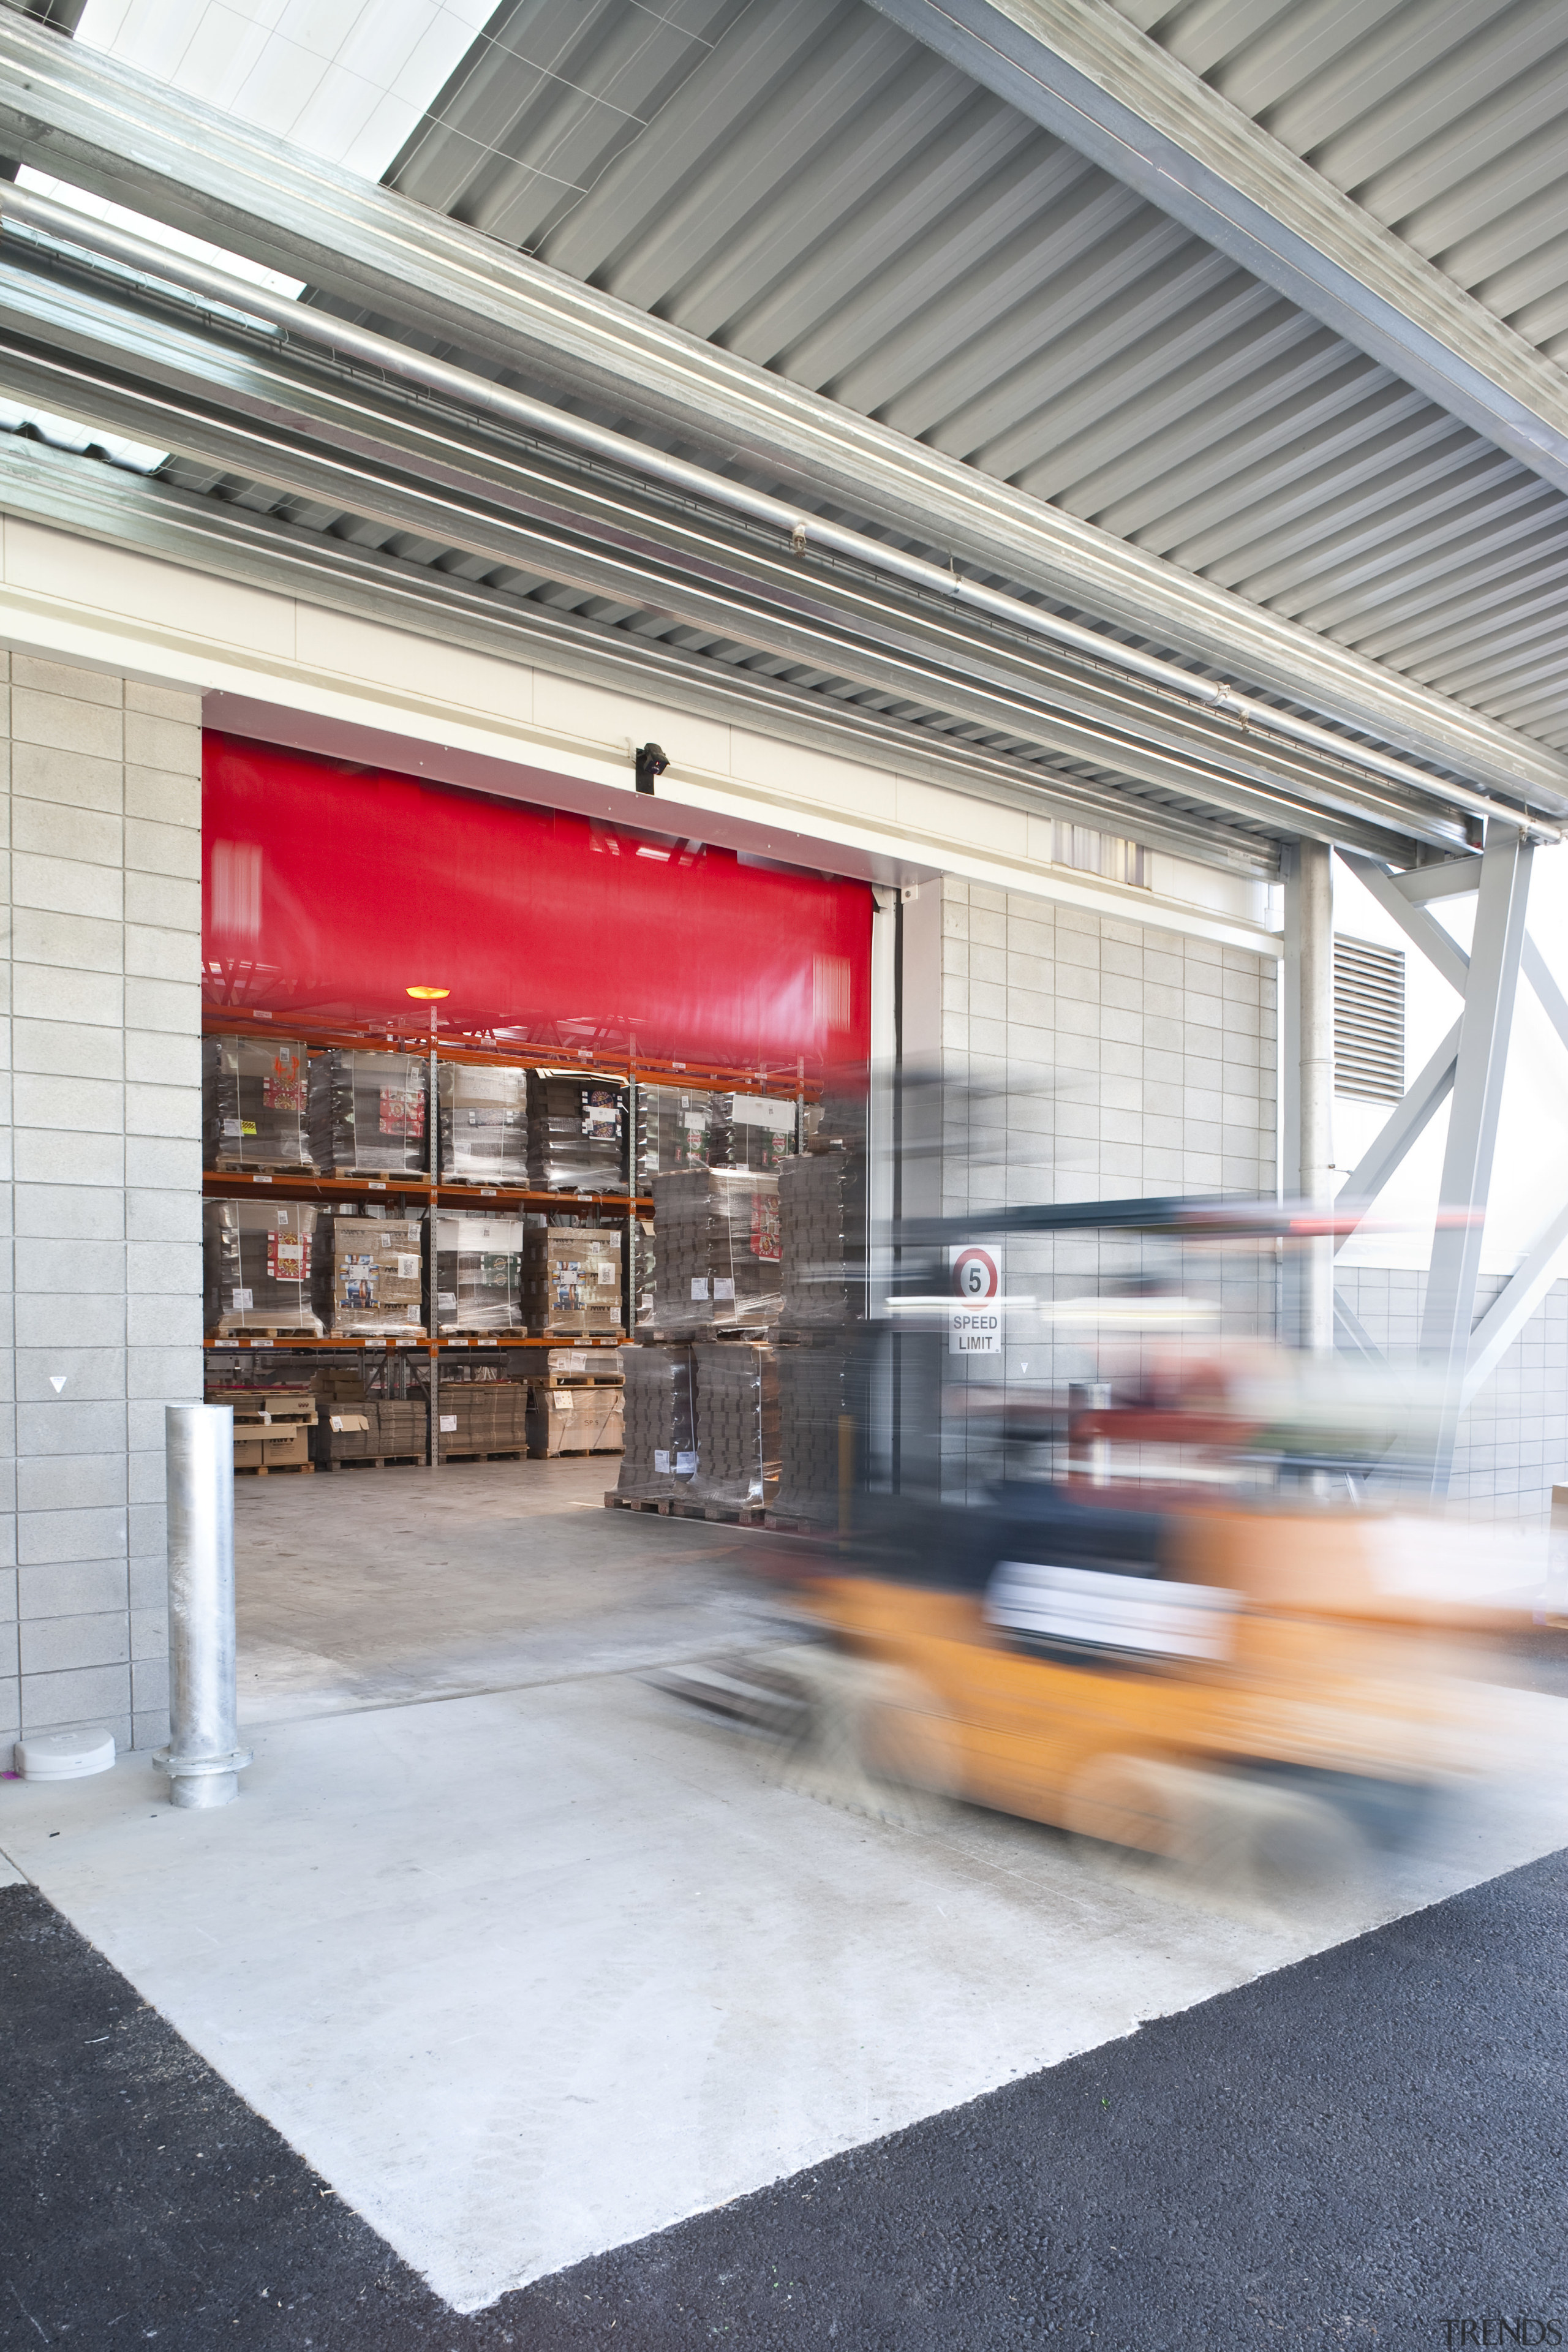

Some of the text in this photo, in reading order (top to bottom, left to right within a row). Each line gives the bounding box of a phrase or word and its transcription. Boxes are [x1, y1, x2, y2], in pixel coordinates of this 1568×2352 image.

[968, 1267, 981, 1292] 5
[953, 1316, 998, 1329] SPEED
[959, 1336, 993, 1349] LIMIT
